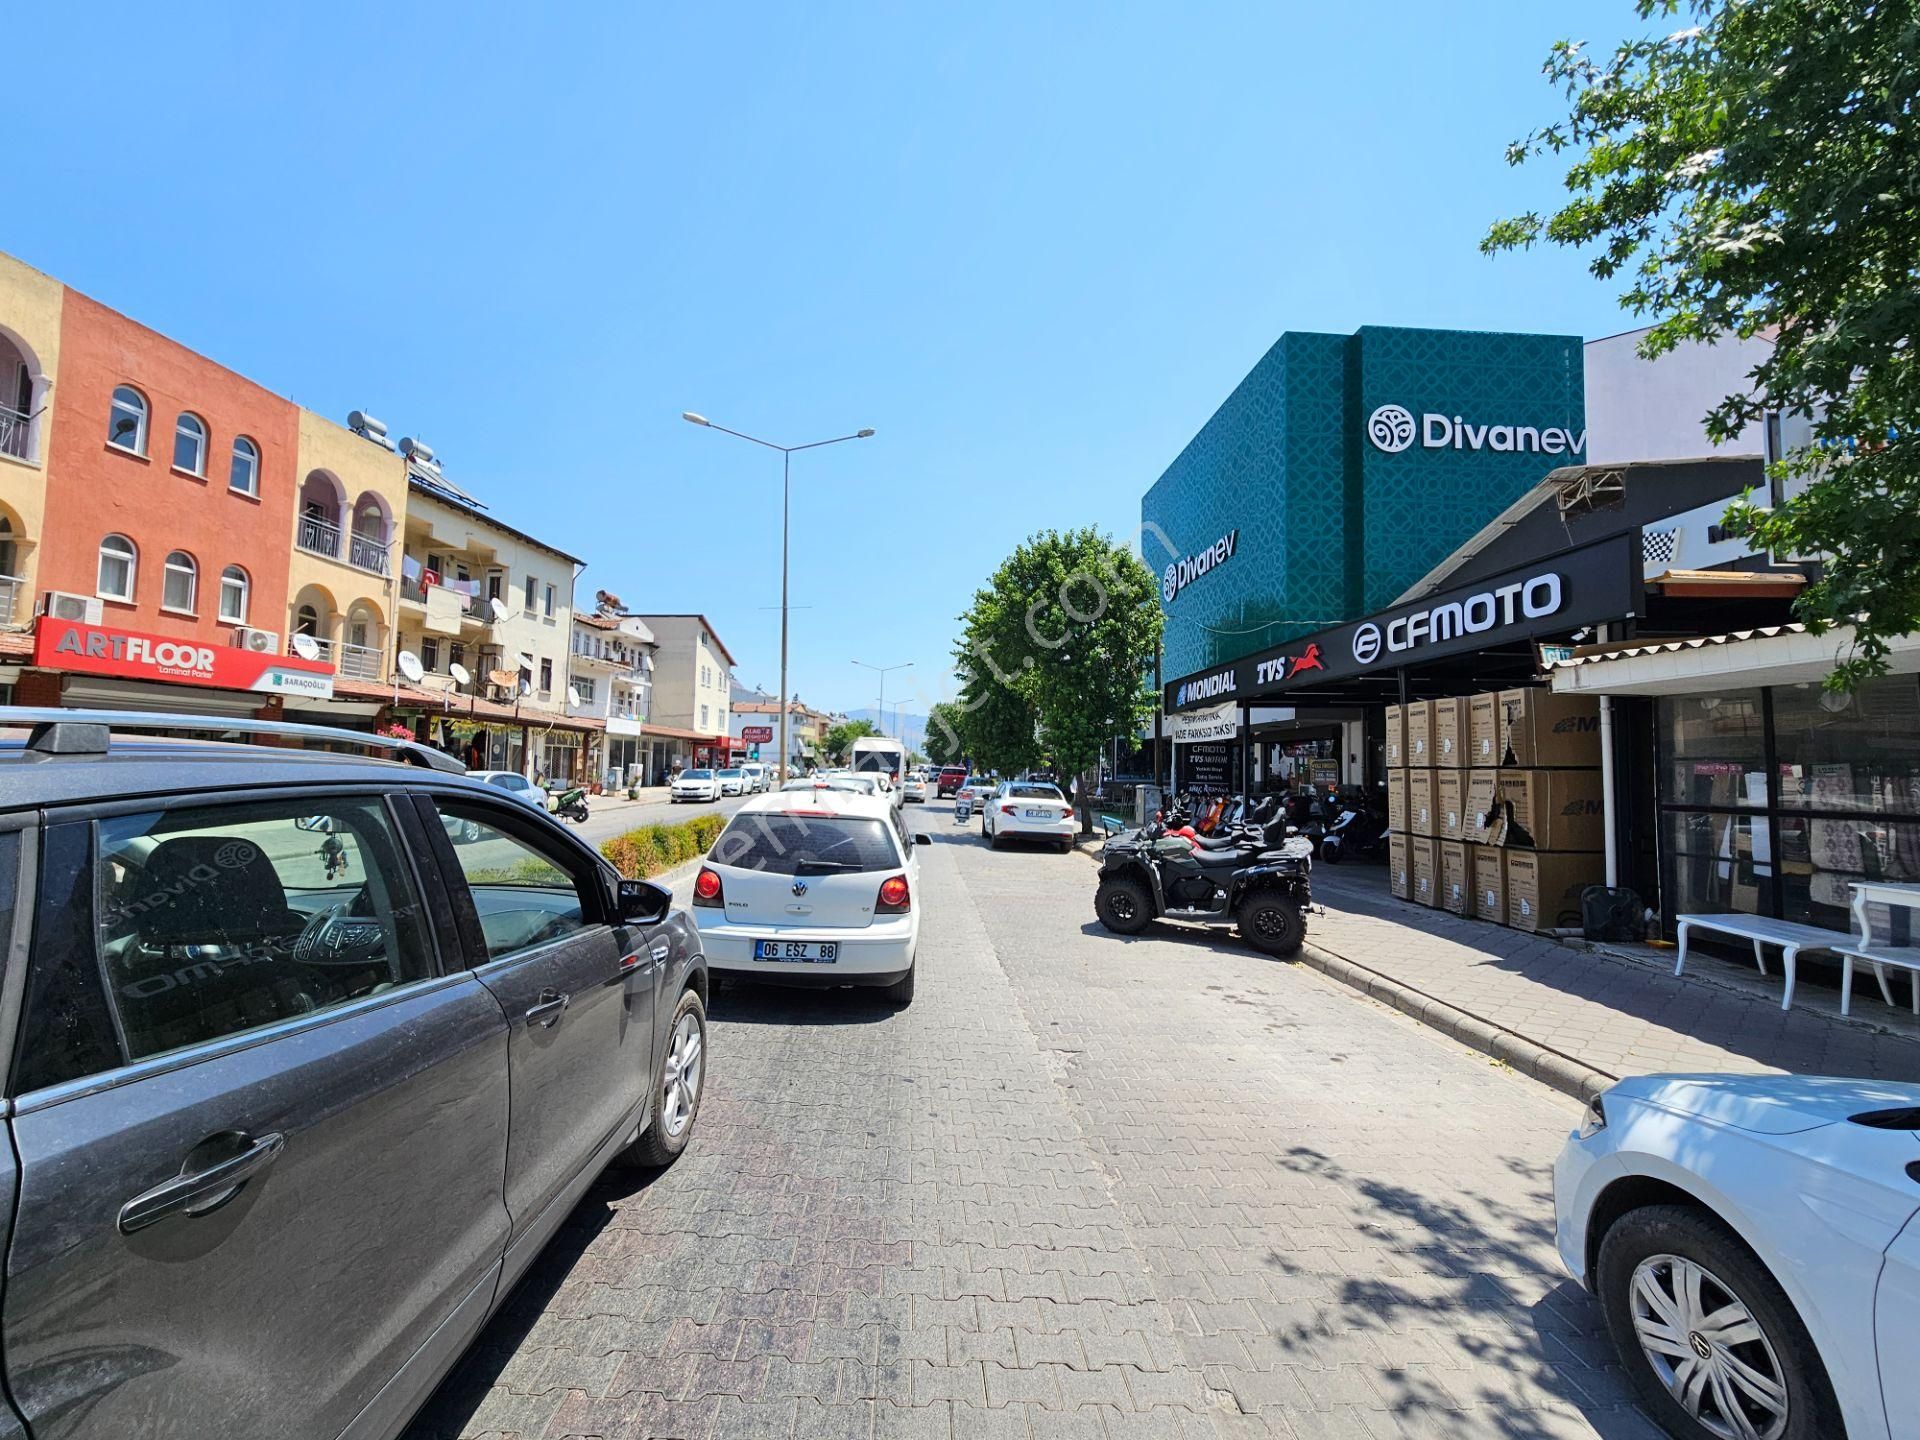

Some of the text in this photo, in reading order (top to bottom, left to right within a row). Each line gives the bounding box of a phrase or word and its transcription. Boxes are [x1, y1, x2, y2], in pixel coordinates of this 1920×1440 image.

[1423, 412, 1587, 455] Divanev
[1178, 529, 1236, 590] Divanev
[1387, 572, 1562, 653] CFMOTO
[55, 627, 215, 672] ARTFLOOR
[1257, 656, 1286, 684] TVS
[1187, 669, 1236, 702] MONDIAL
[764, 943, 834, 958] 06 ESZ 88
